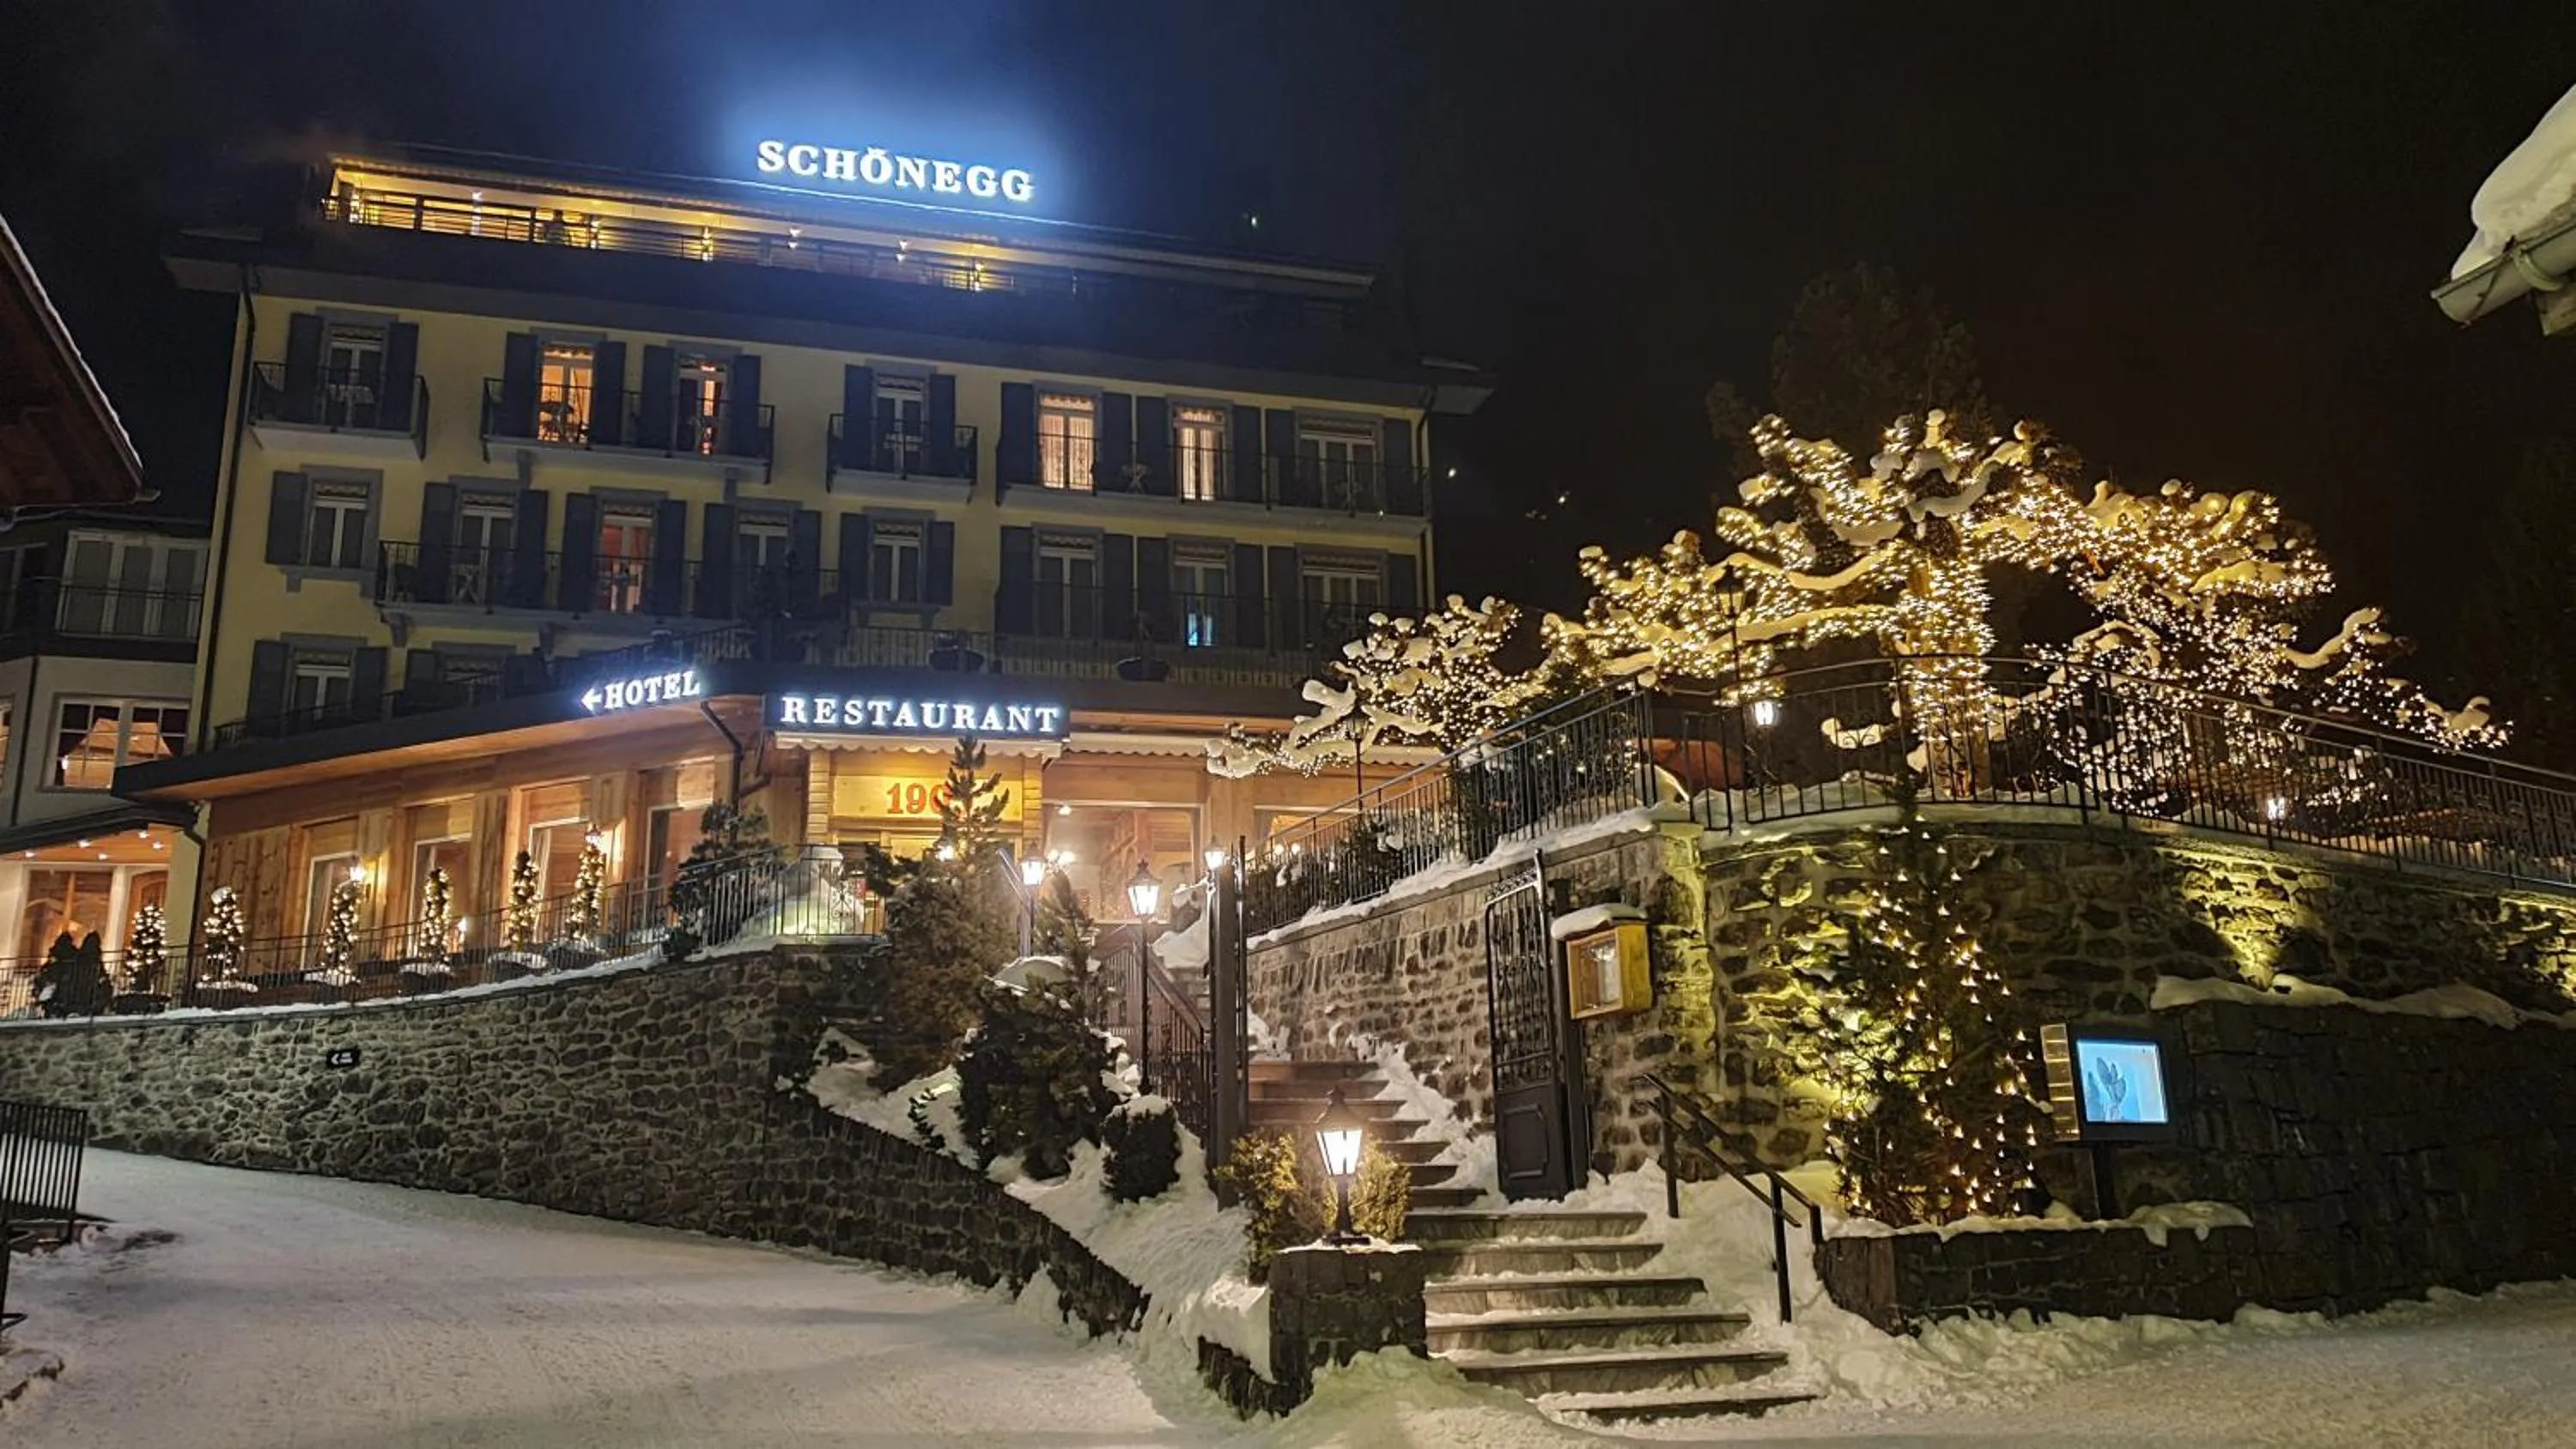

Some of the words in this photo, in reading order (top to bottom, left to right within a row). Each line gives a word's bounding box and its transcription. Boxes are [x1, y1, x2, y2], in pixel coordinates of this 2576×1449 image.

[756, 140, 1036, 202] SCHÖNEGG
[604, 669, 702, 700] HOTEL
[781, 696, 1060, 733] RESTAURANT
